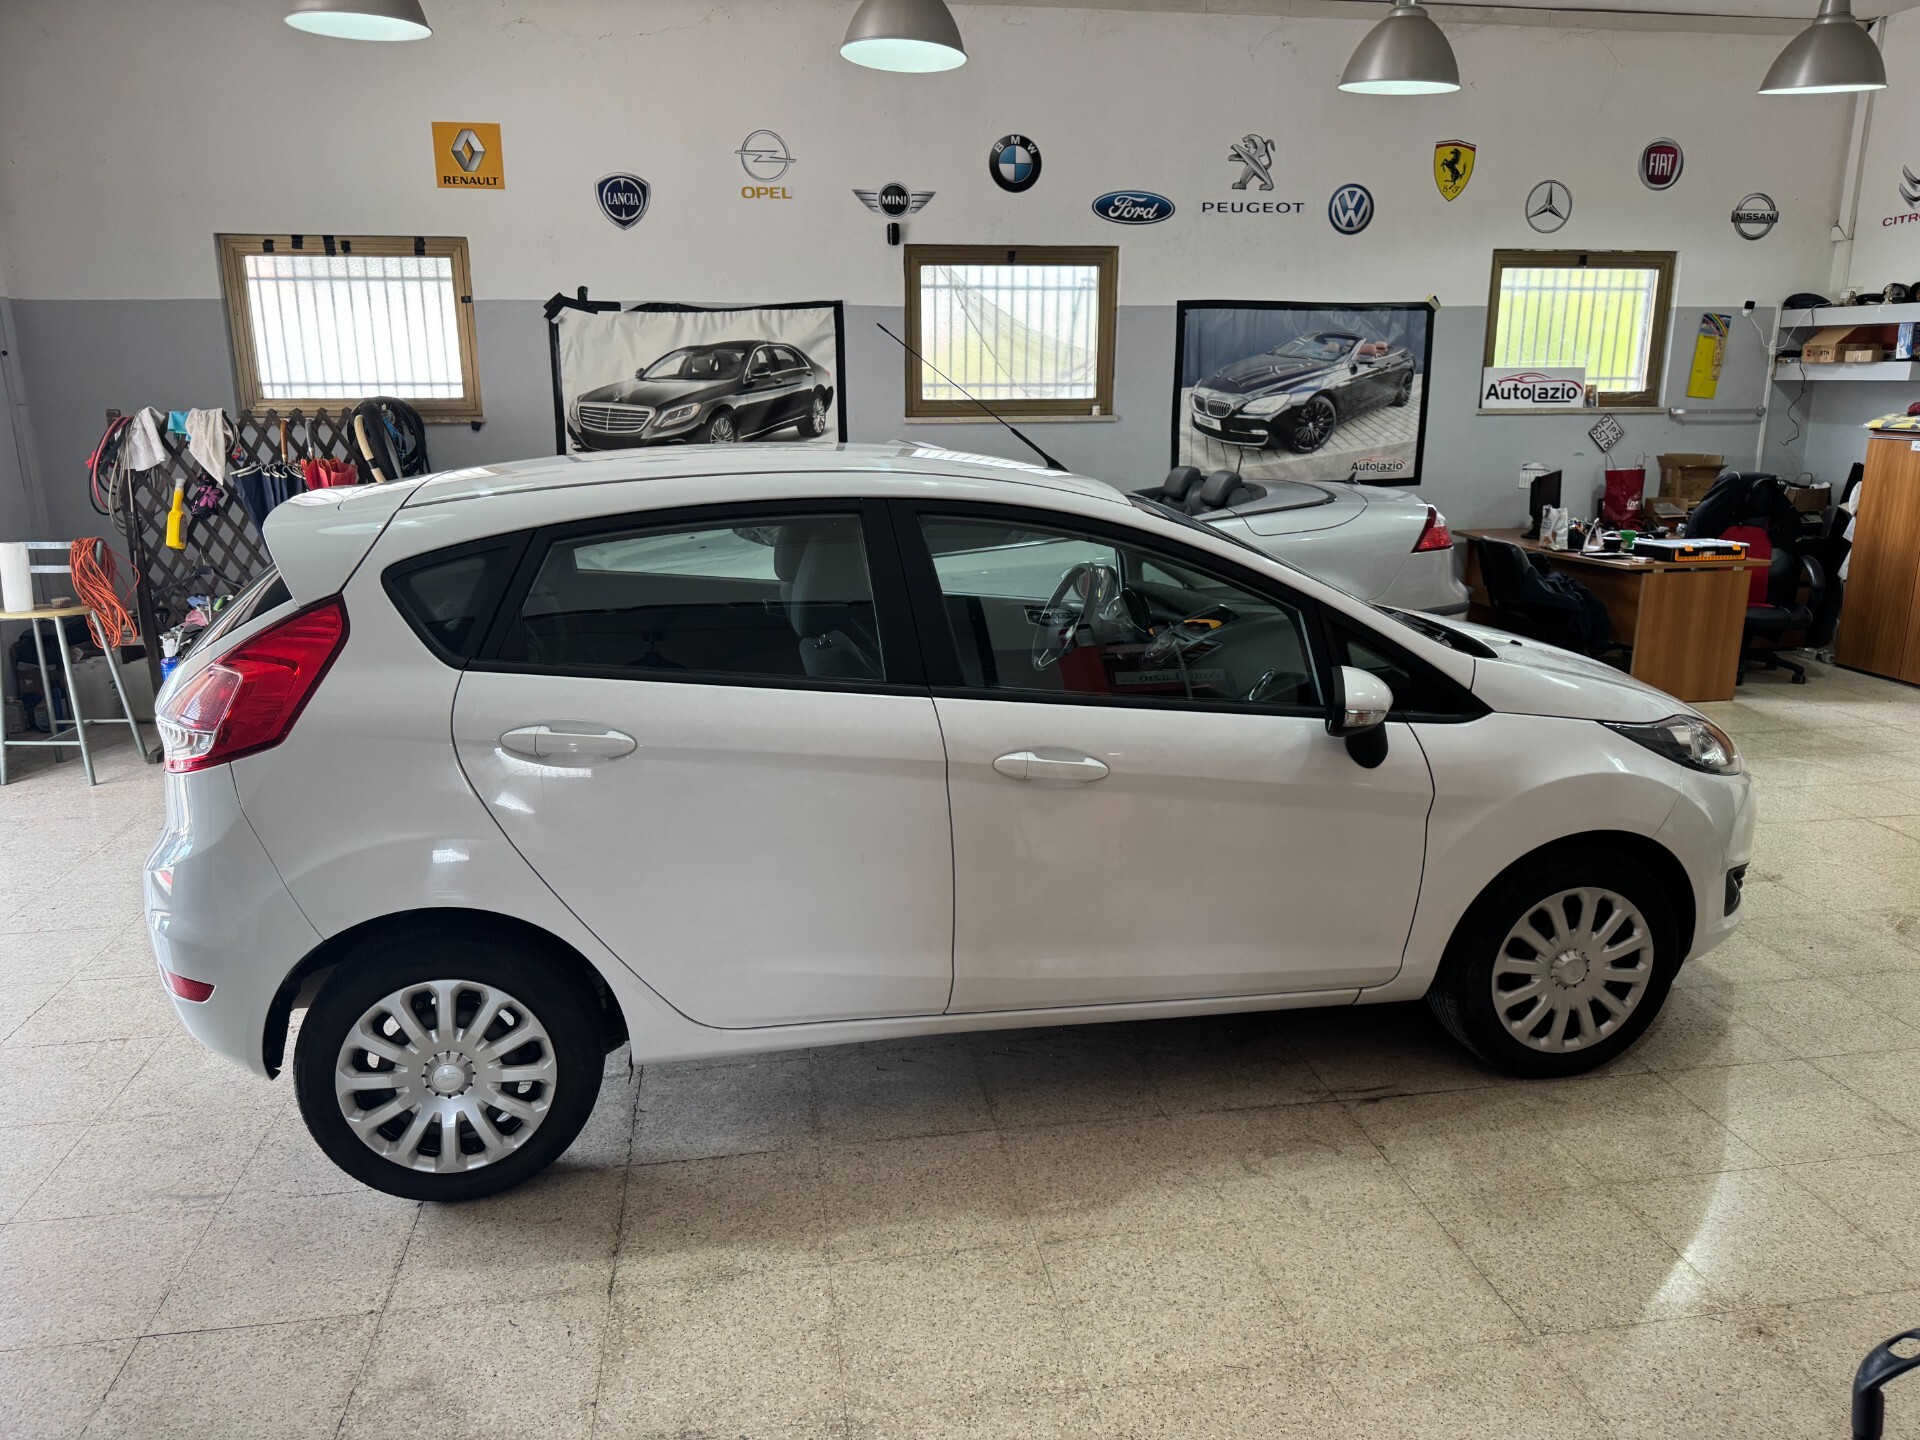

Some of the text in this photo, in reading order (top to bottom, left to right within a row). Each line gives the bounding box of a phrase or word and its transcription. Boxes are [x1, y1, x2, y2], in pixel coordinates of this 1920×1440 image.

[994, 135, 1037, 154] BMW
[1648, 153, 1675, 176] FIAT
[443, 175, 499, 186] RENAULT
[607, 192, 640, 206] LANCIA
[741, 186, 793, 199] OPEL
[881, 195, 907, 206] MINI
[1108, 195, 1159, 219] Ford
[1201, 202, 1305, 213] PEUGEOT
[1735, 212, 1774, 221] NISSAN
[1882, 212, 1920, 227] CITR
[1485, 383, 1577, 403] AutoLazio
[1350, 460, 1403, 473] AutoLazio
